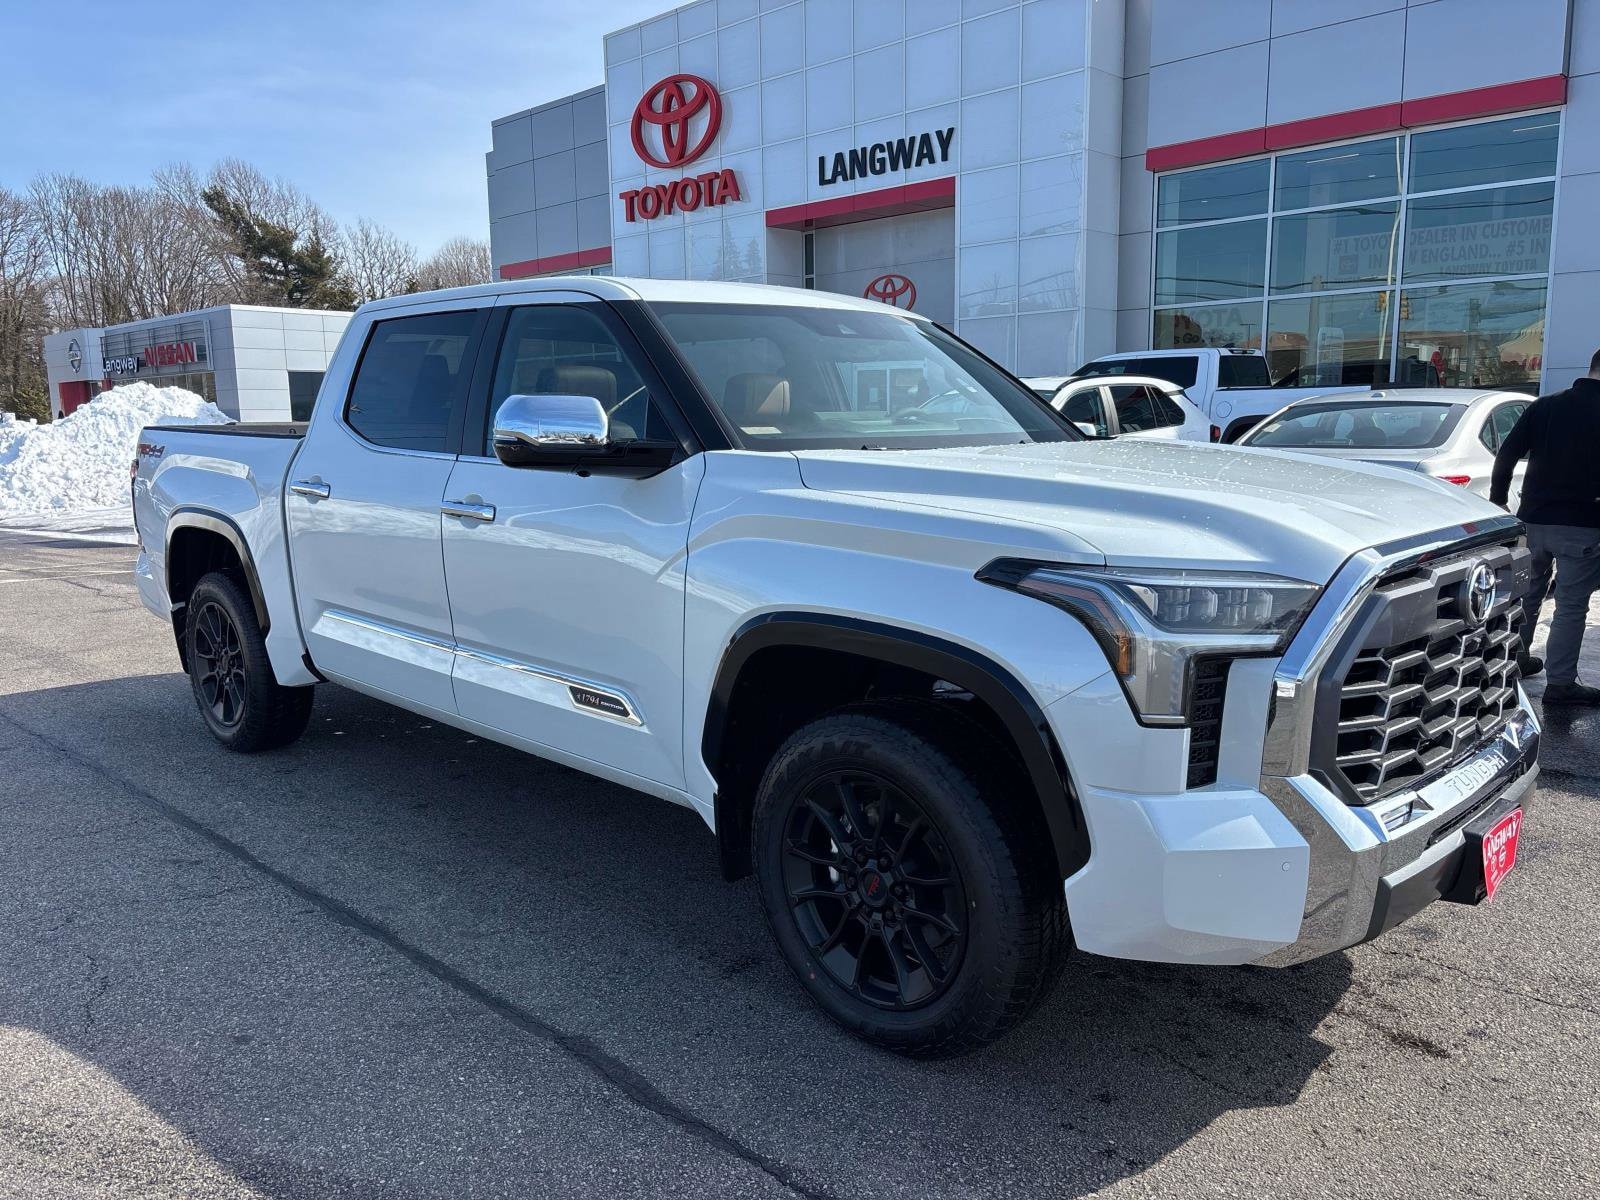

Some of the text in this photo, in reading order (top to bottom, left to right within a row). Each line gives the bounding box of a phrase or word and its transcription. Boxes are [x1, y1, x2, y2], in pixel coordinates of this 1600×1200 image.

[818, 127, 955, 186] LANGWAY
[619, 168, 741, 222] TOYOTA
[1409, 227, 1457, 247] DEALER
[1462, 225, 1478, 241] IN
[1482, 217, 1552, 239] CUSTOME
[102, 342, 197, 374] Langway NISSAN
[582, 693, 600, 705] 1794
[1483, 818, 1521, 866] LANGWAY
